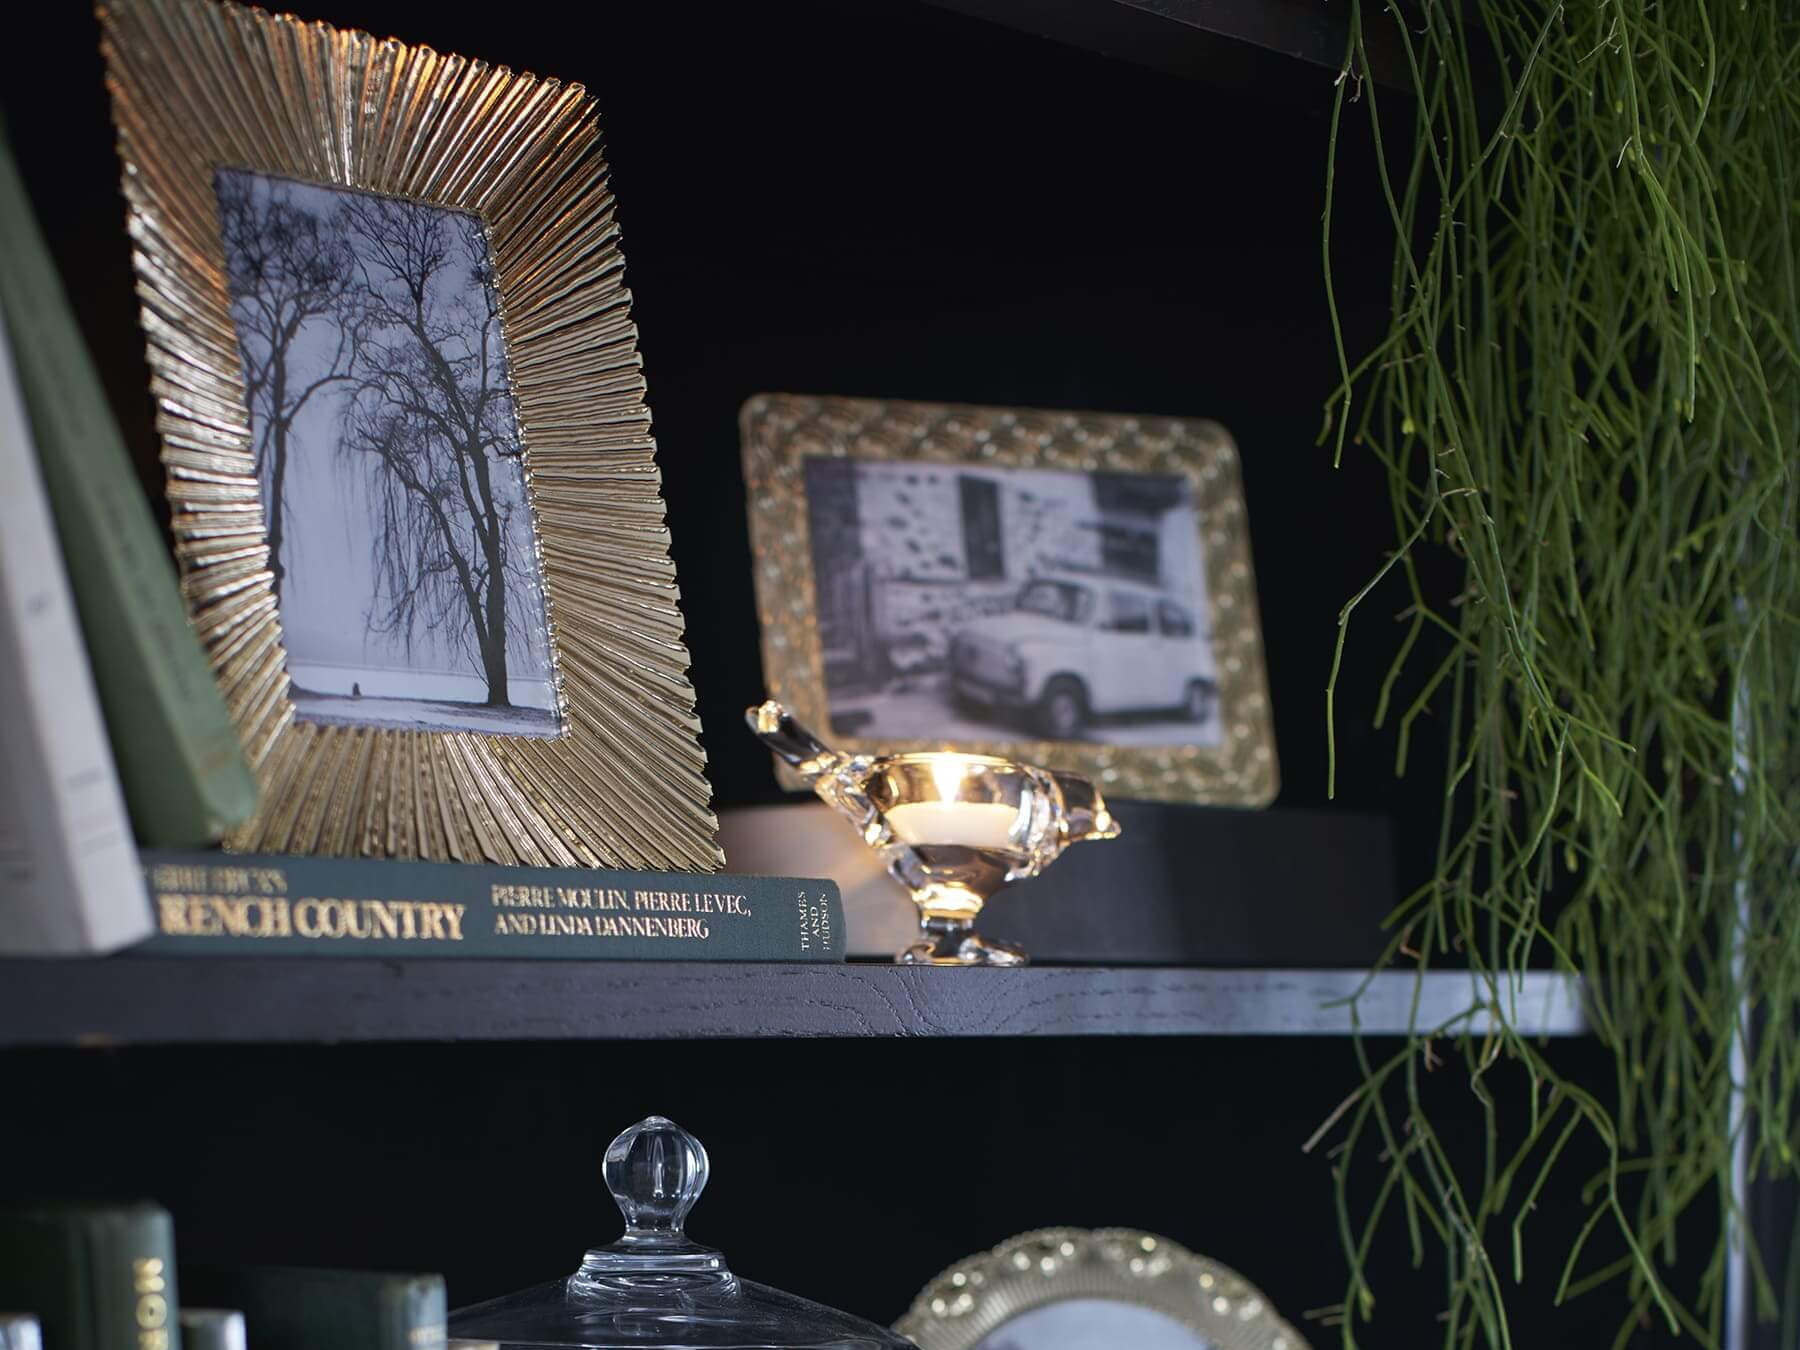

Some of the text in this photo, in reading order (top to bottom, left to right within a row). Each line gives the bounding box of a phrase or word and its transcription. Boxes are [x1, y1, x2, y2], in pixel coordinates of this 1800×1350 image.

[491, 884, 555, 909] PIERRE
[634, 892, 692, 913] PIERRE
[157, 893, 465, 940] RENCH COUNTRY
[495, 913, 710, 940] AND LINDA DANNENBERG
[798, 891, 811, 952] THAMES
[810, 906, 820, 938] AND
